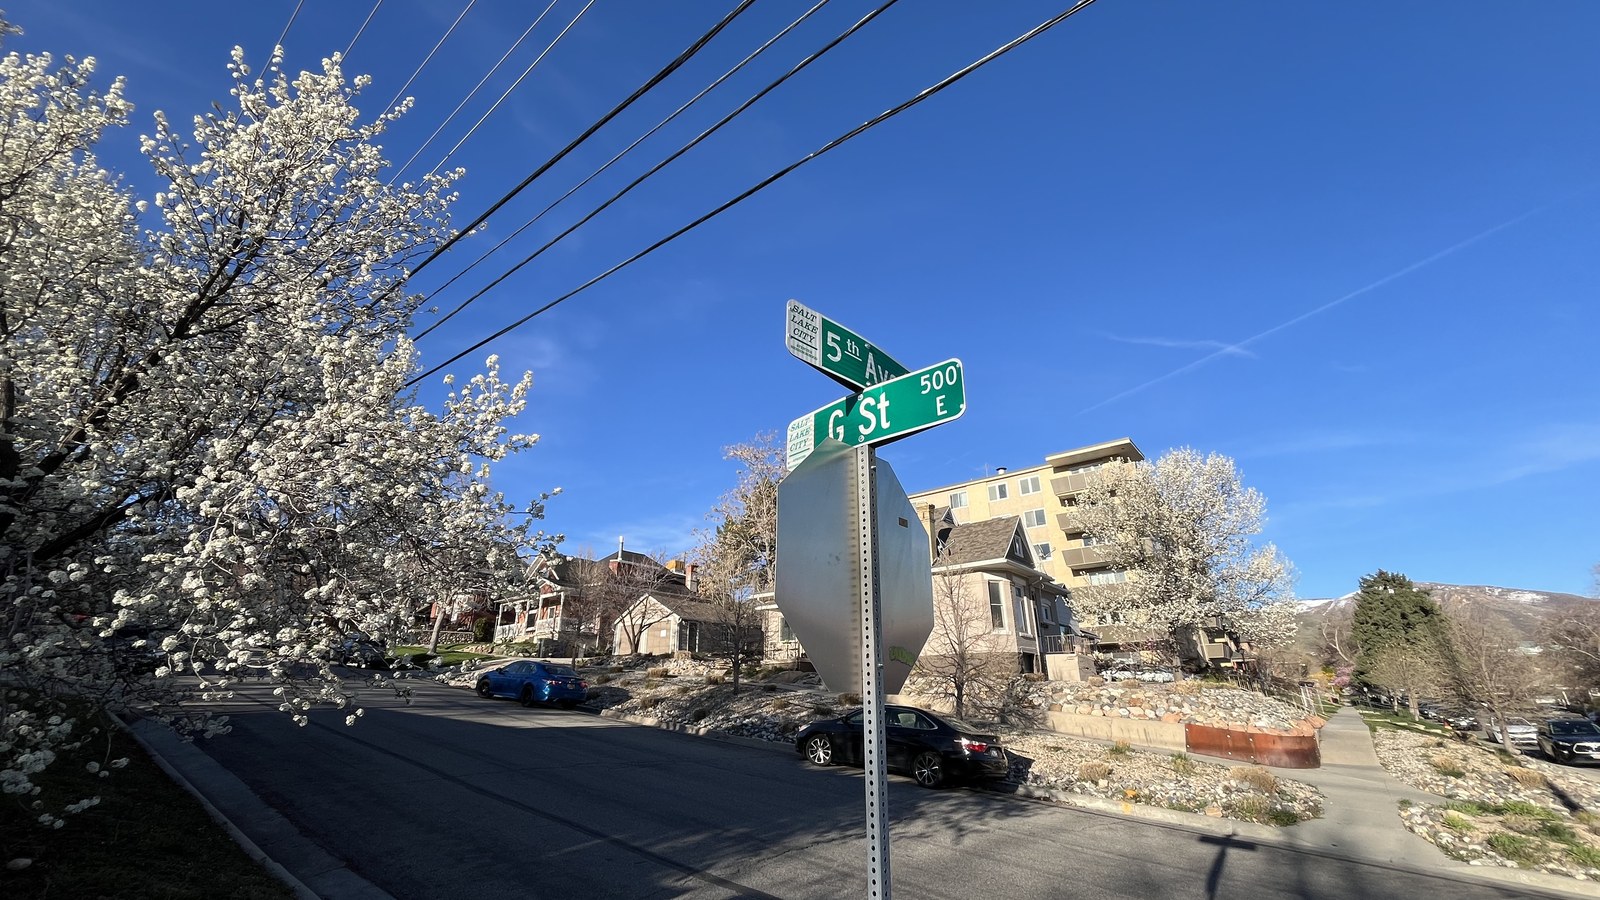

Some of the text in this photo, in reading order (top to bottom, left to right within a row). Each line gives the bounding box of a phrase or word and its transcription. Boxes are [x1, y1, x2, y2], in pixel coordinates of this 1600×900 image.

[791, 304, 817, 322] SALT
[791, 315, 818, 334] LAKE
[793, 328, 815, 343] CITY
[920, 366, 957, 395] 500
[936, 394, 948, 416] E
[790, 417, 810, 432] SALT
[828, 391, 891, 442] G St
[789, 427, 810, 442] LAKE
[790, 438, 809, 452] CITY
